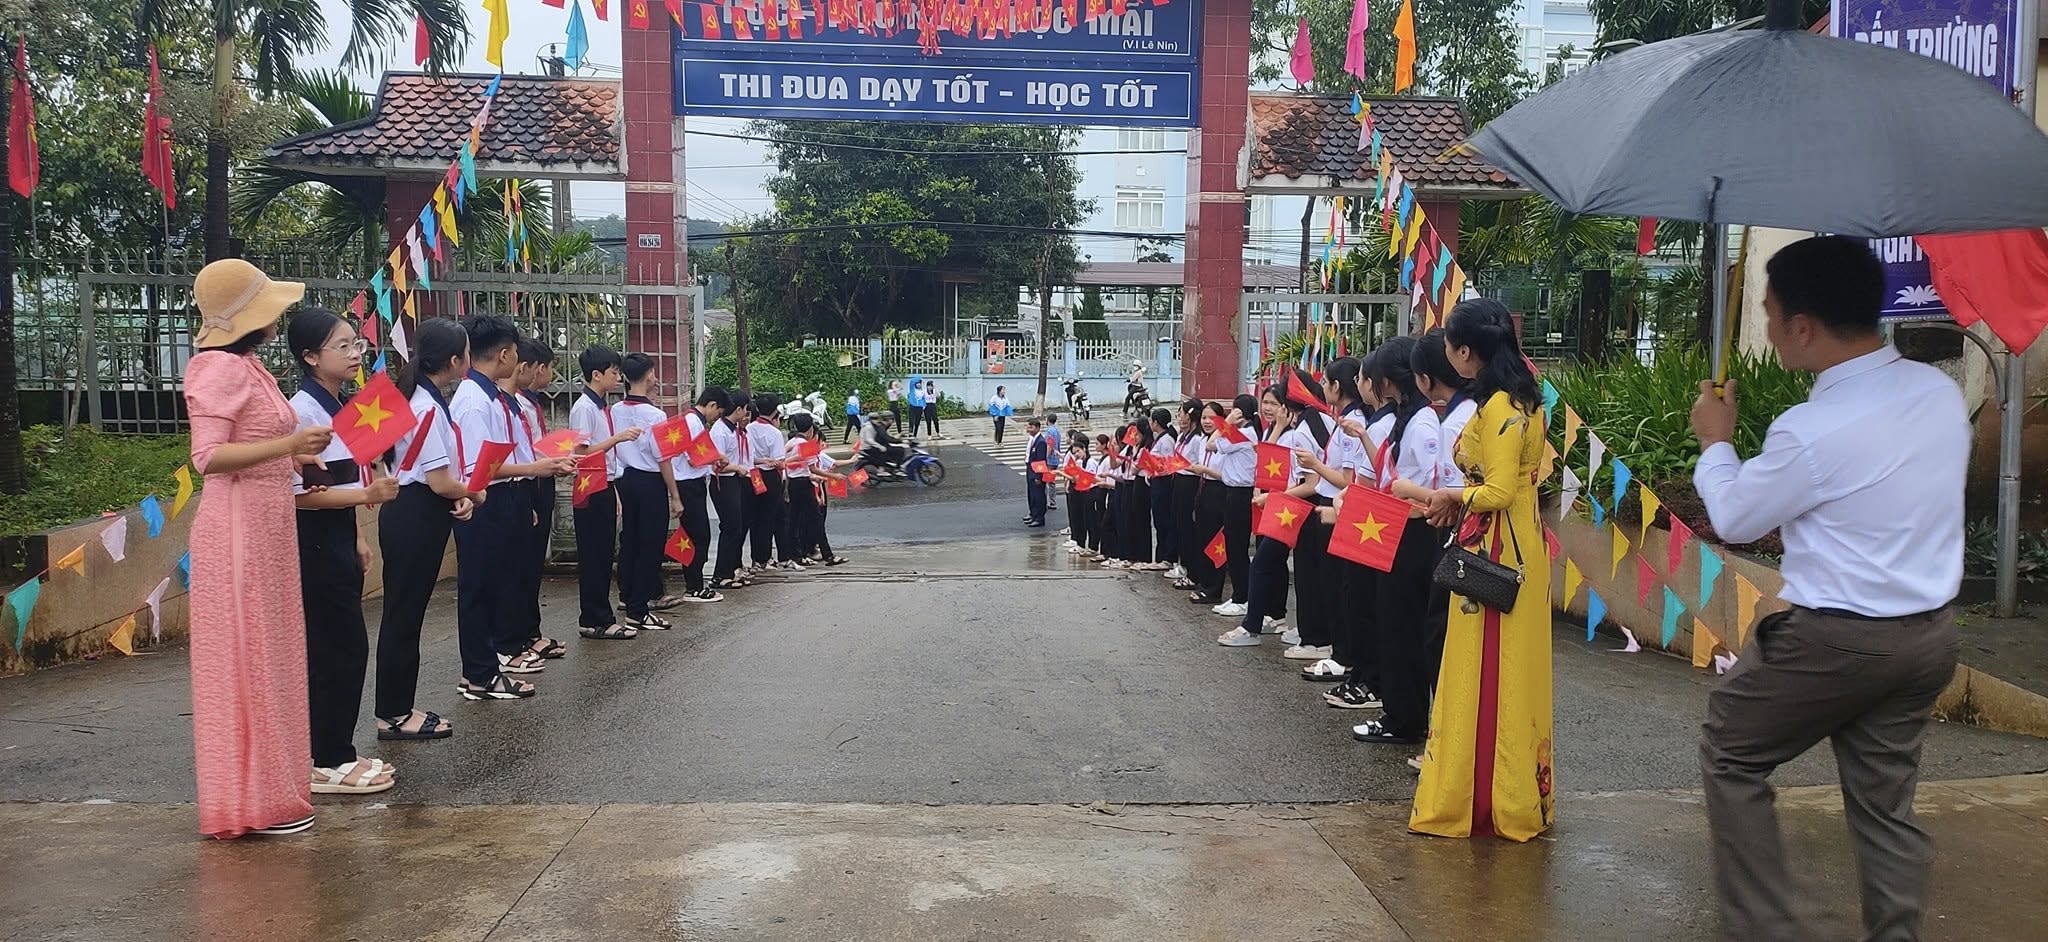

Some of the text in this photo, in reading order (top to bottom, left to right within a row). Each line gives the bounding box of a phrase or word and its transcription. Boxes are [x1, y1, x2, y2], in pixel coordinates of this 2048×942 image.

[1088, 3, 1153, 37] MÃI
[1141, 40, 1154, 50] Lê
[719, 73, 771, 98] THI
[780, 75, 849, 100] ĐUA
[860, 77, 922, 108] DẠY
[932, 73, 990, 104] TỐT
[1026, 81, 1091, 112] HỌC
[1102, 78, 1158, 108] TỐT
